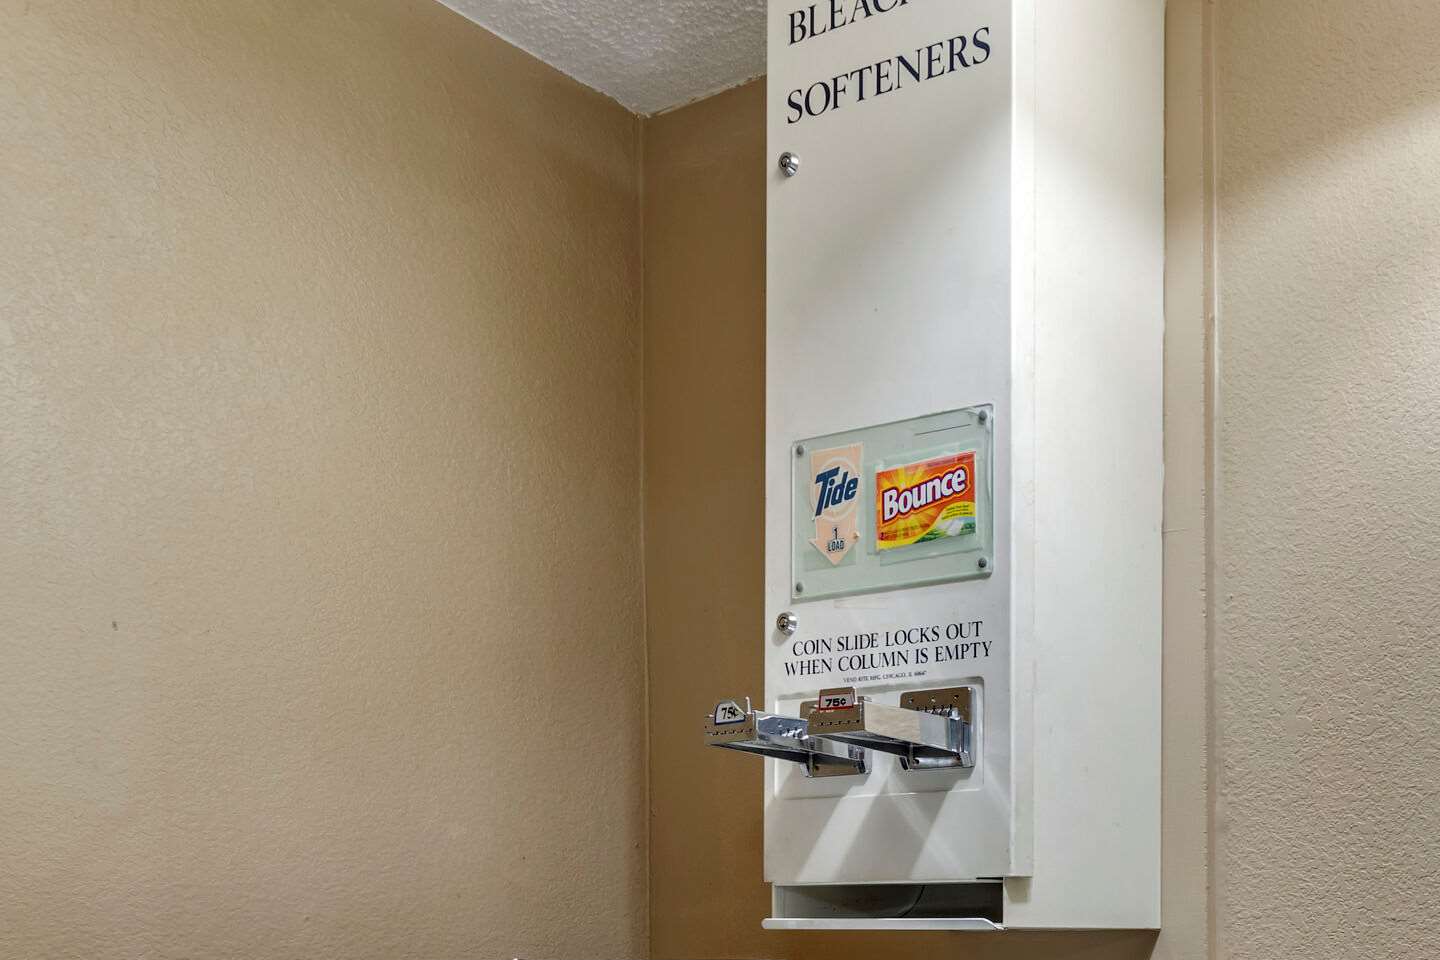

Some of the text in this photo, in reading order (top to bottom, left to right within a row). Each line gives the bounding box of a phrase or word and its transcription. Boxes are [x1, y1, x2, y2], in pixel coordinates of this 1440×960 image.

[788, 0, 909, 45] BLEA
[787, 27, 991, 124] SOFTENERS
[814, 466, 859, 517] Tide
[882, 467, 966, 522] Bounce
[827, 540, 845, 552] LOAD
[832, 527, 839, 539] 1
[792, 620, 983, 657] COIN SLIDE LOCKS OUT
[784, 640, 993, 677] WHEN COLUMN IS EMPTY
[721, 705, 739, 720] 75¢
[824, 697, 847, 707] 75¢
